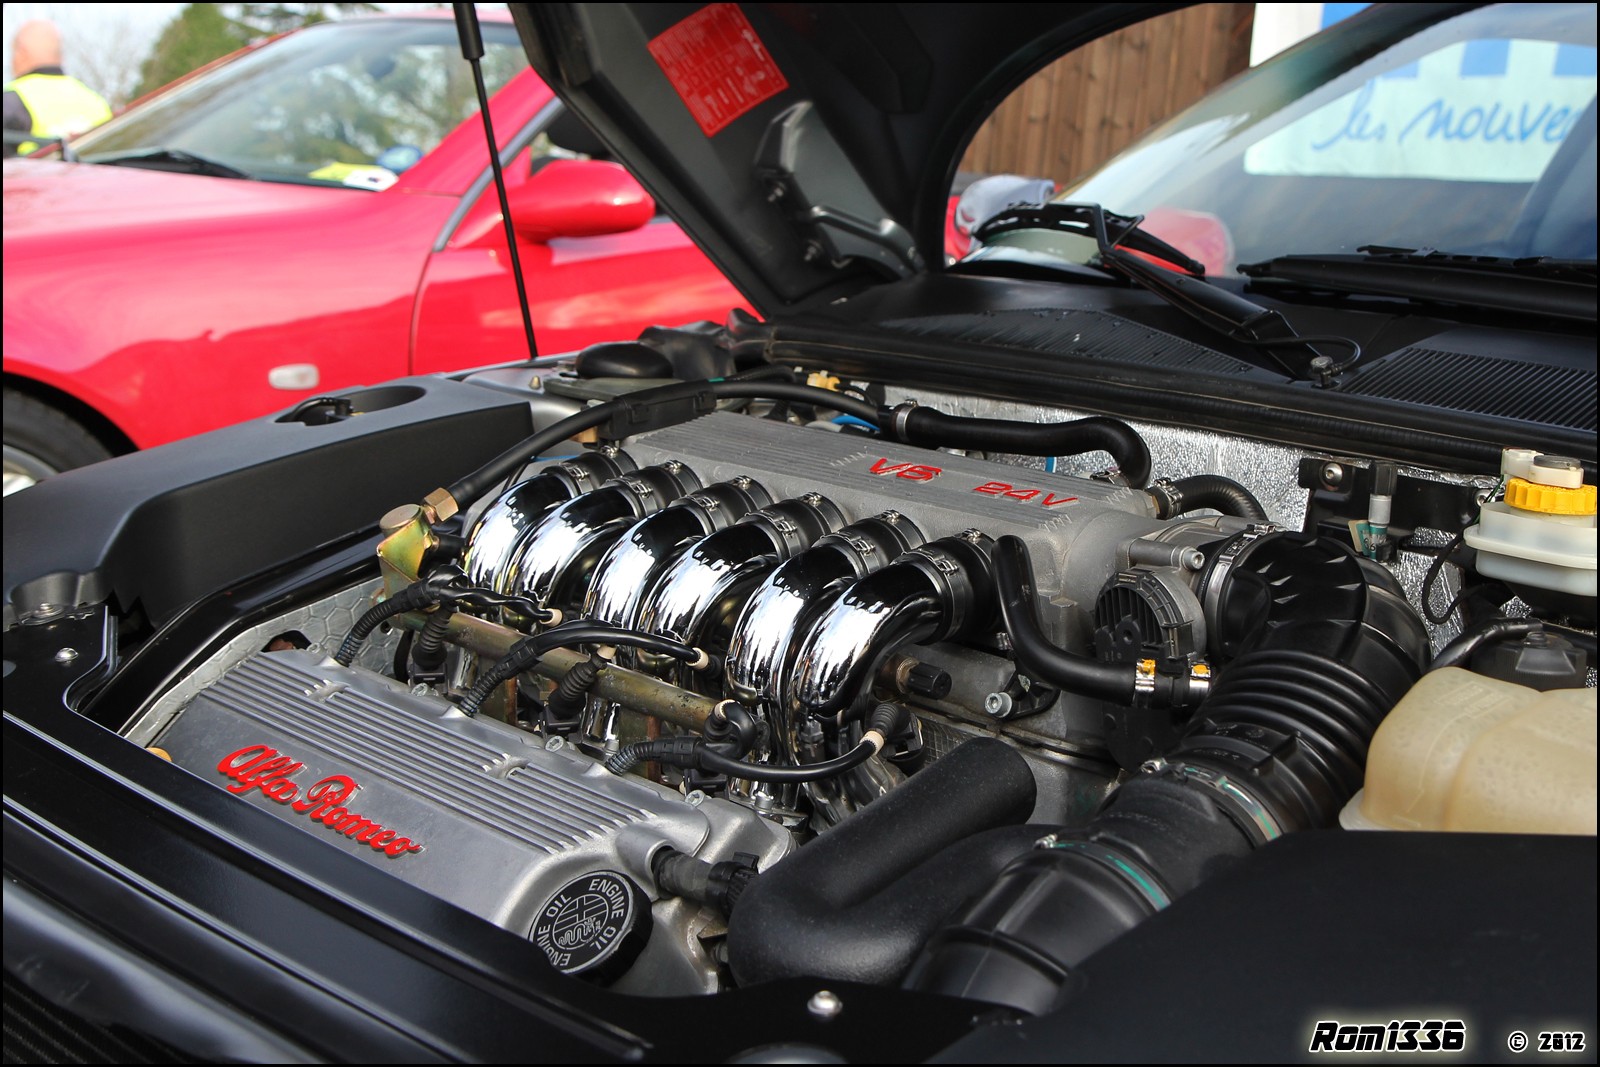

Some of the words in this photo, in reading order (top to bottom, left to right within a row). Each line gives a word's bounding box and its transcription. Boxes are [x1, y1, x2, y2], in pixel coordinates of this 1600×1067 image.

[869, 457, 942, 482] V6
[973, 481, 1079, 508] 24V
[216, 744, 304, 803] Alfa
[291, 774, 421, 856] Romeo
[545, 894, 572, 918] OIL
[588, 878, 625, 919] ENGINE
[590, 926, 617, 950] OIL
